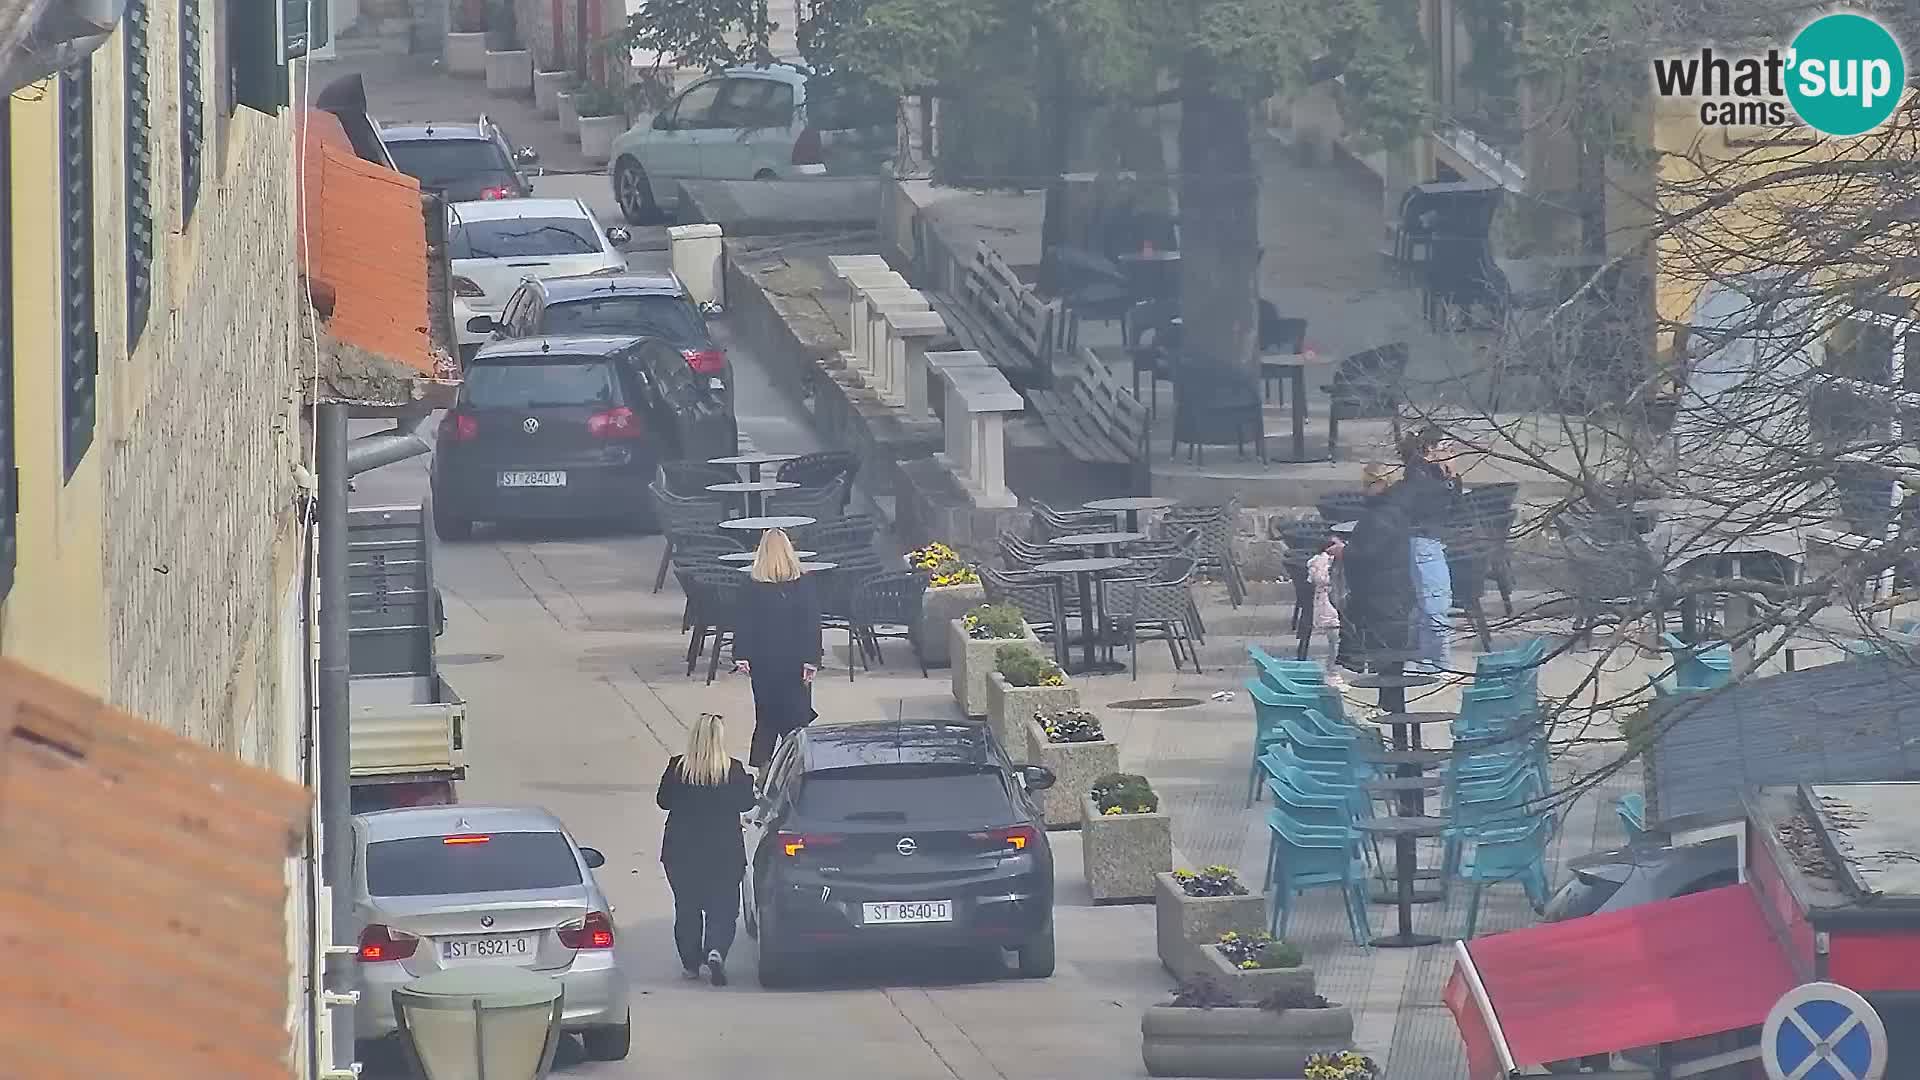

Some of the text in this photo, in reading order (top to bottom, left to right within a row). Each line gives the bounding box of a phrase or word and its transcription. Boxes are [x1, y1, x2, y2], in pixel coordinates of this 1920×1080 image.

[504, 473, 516, 485] ST
[874, 905, 890, 920] ST
[452, 942, 469, 957] ST
